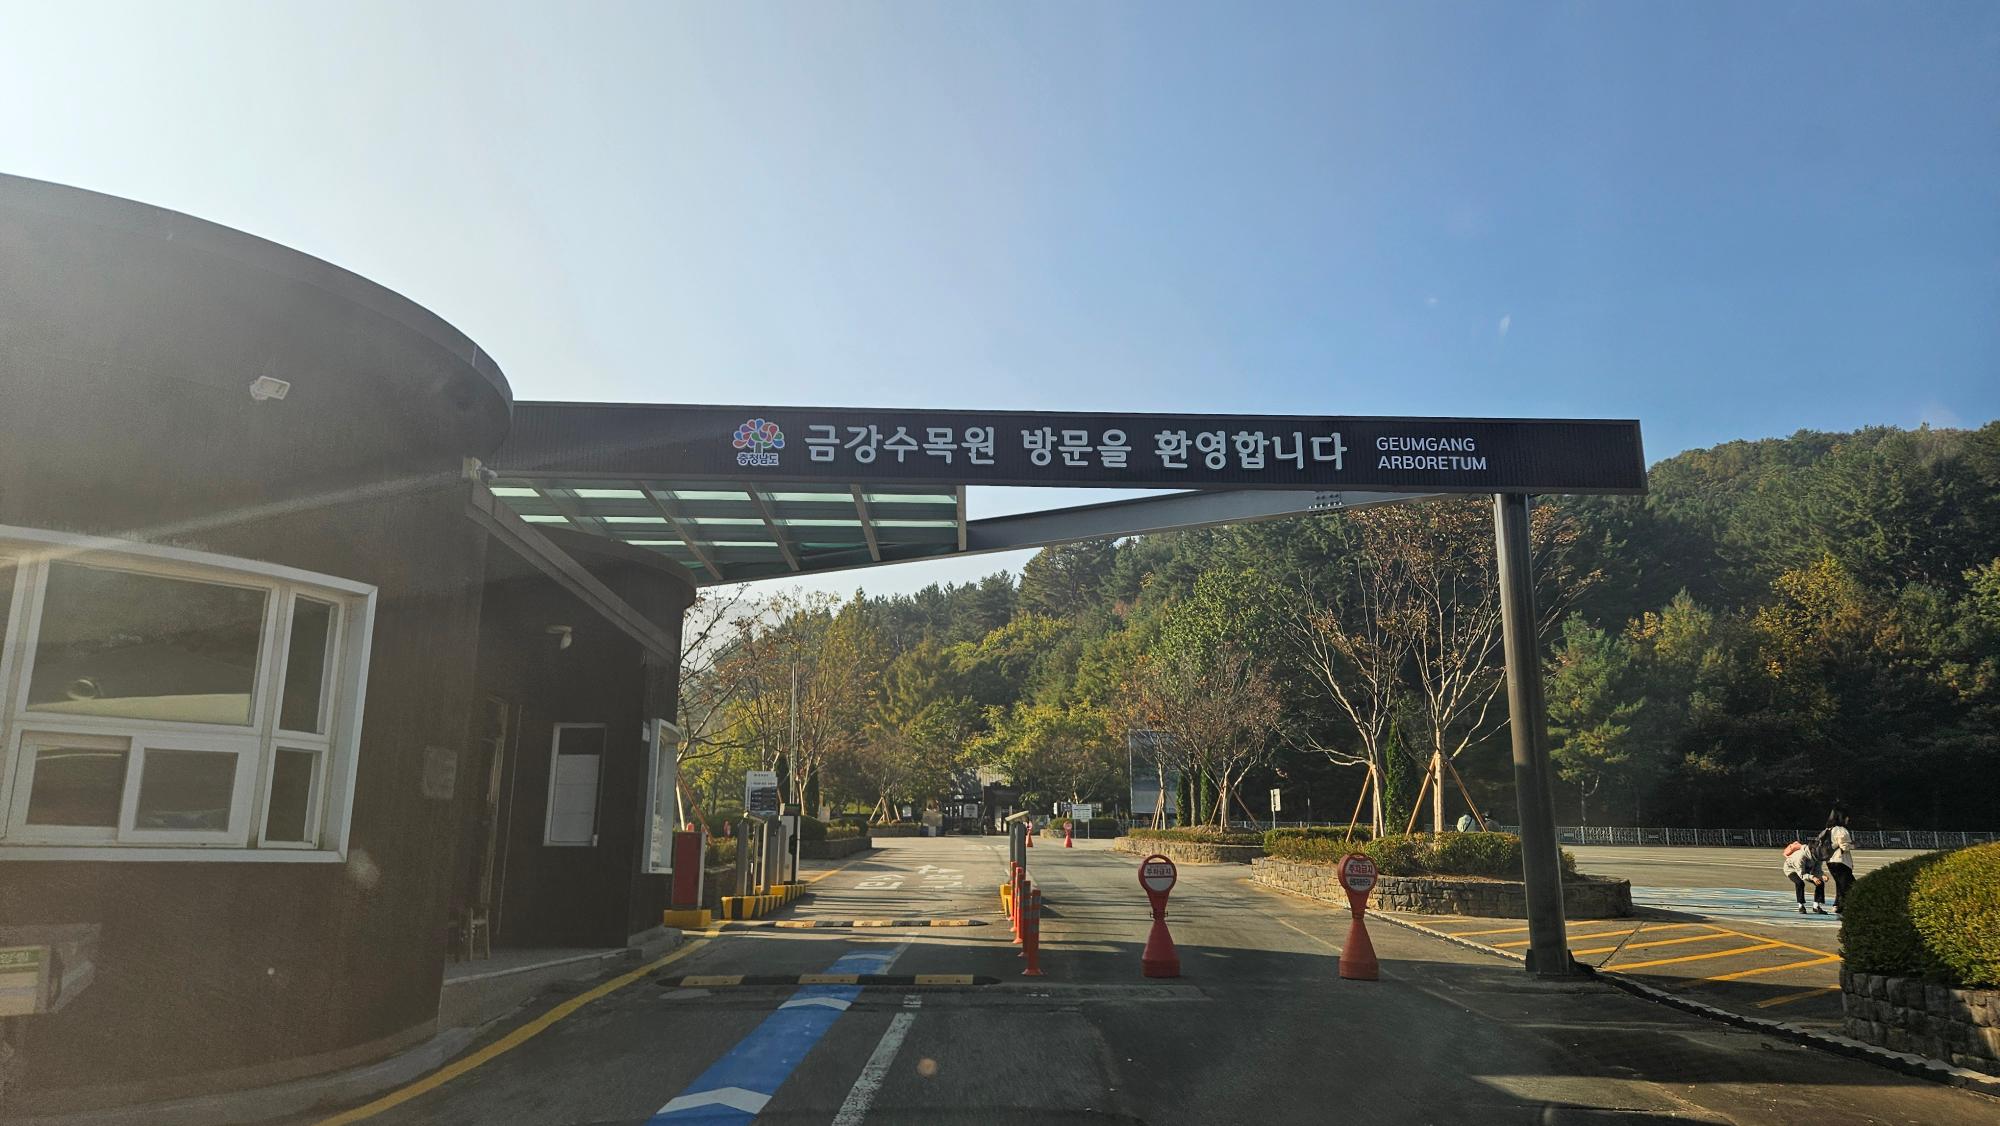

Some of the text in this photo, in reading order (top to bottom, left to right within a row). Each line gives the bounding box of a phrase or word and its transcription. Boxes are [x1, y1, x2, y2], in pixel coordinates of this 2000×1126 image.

[804, 425, 1348, 470] 금강수목원 방문을 환영합니다
[1376, 437, 1475, 452] GEUMGANG
[737, 453, 779, 466] 충청남도
[1378, 455, 1487, 471] ARBORETUM
